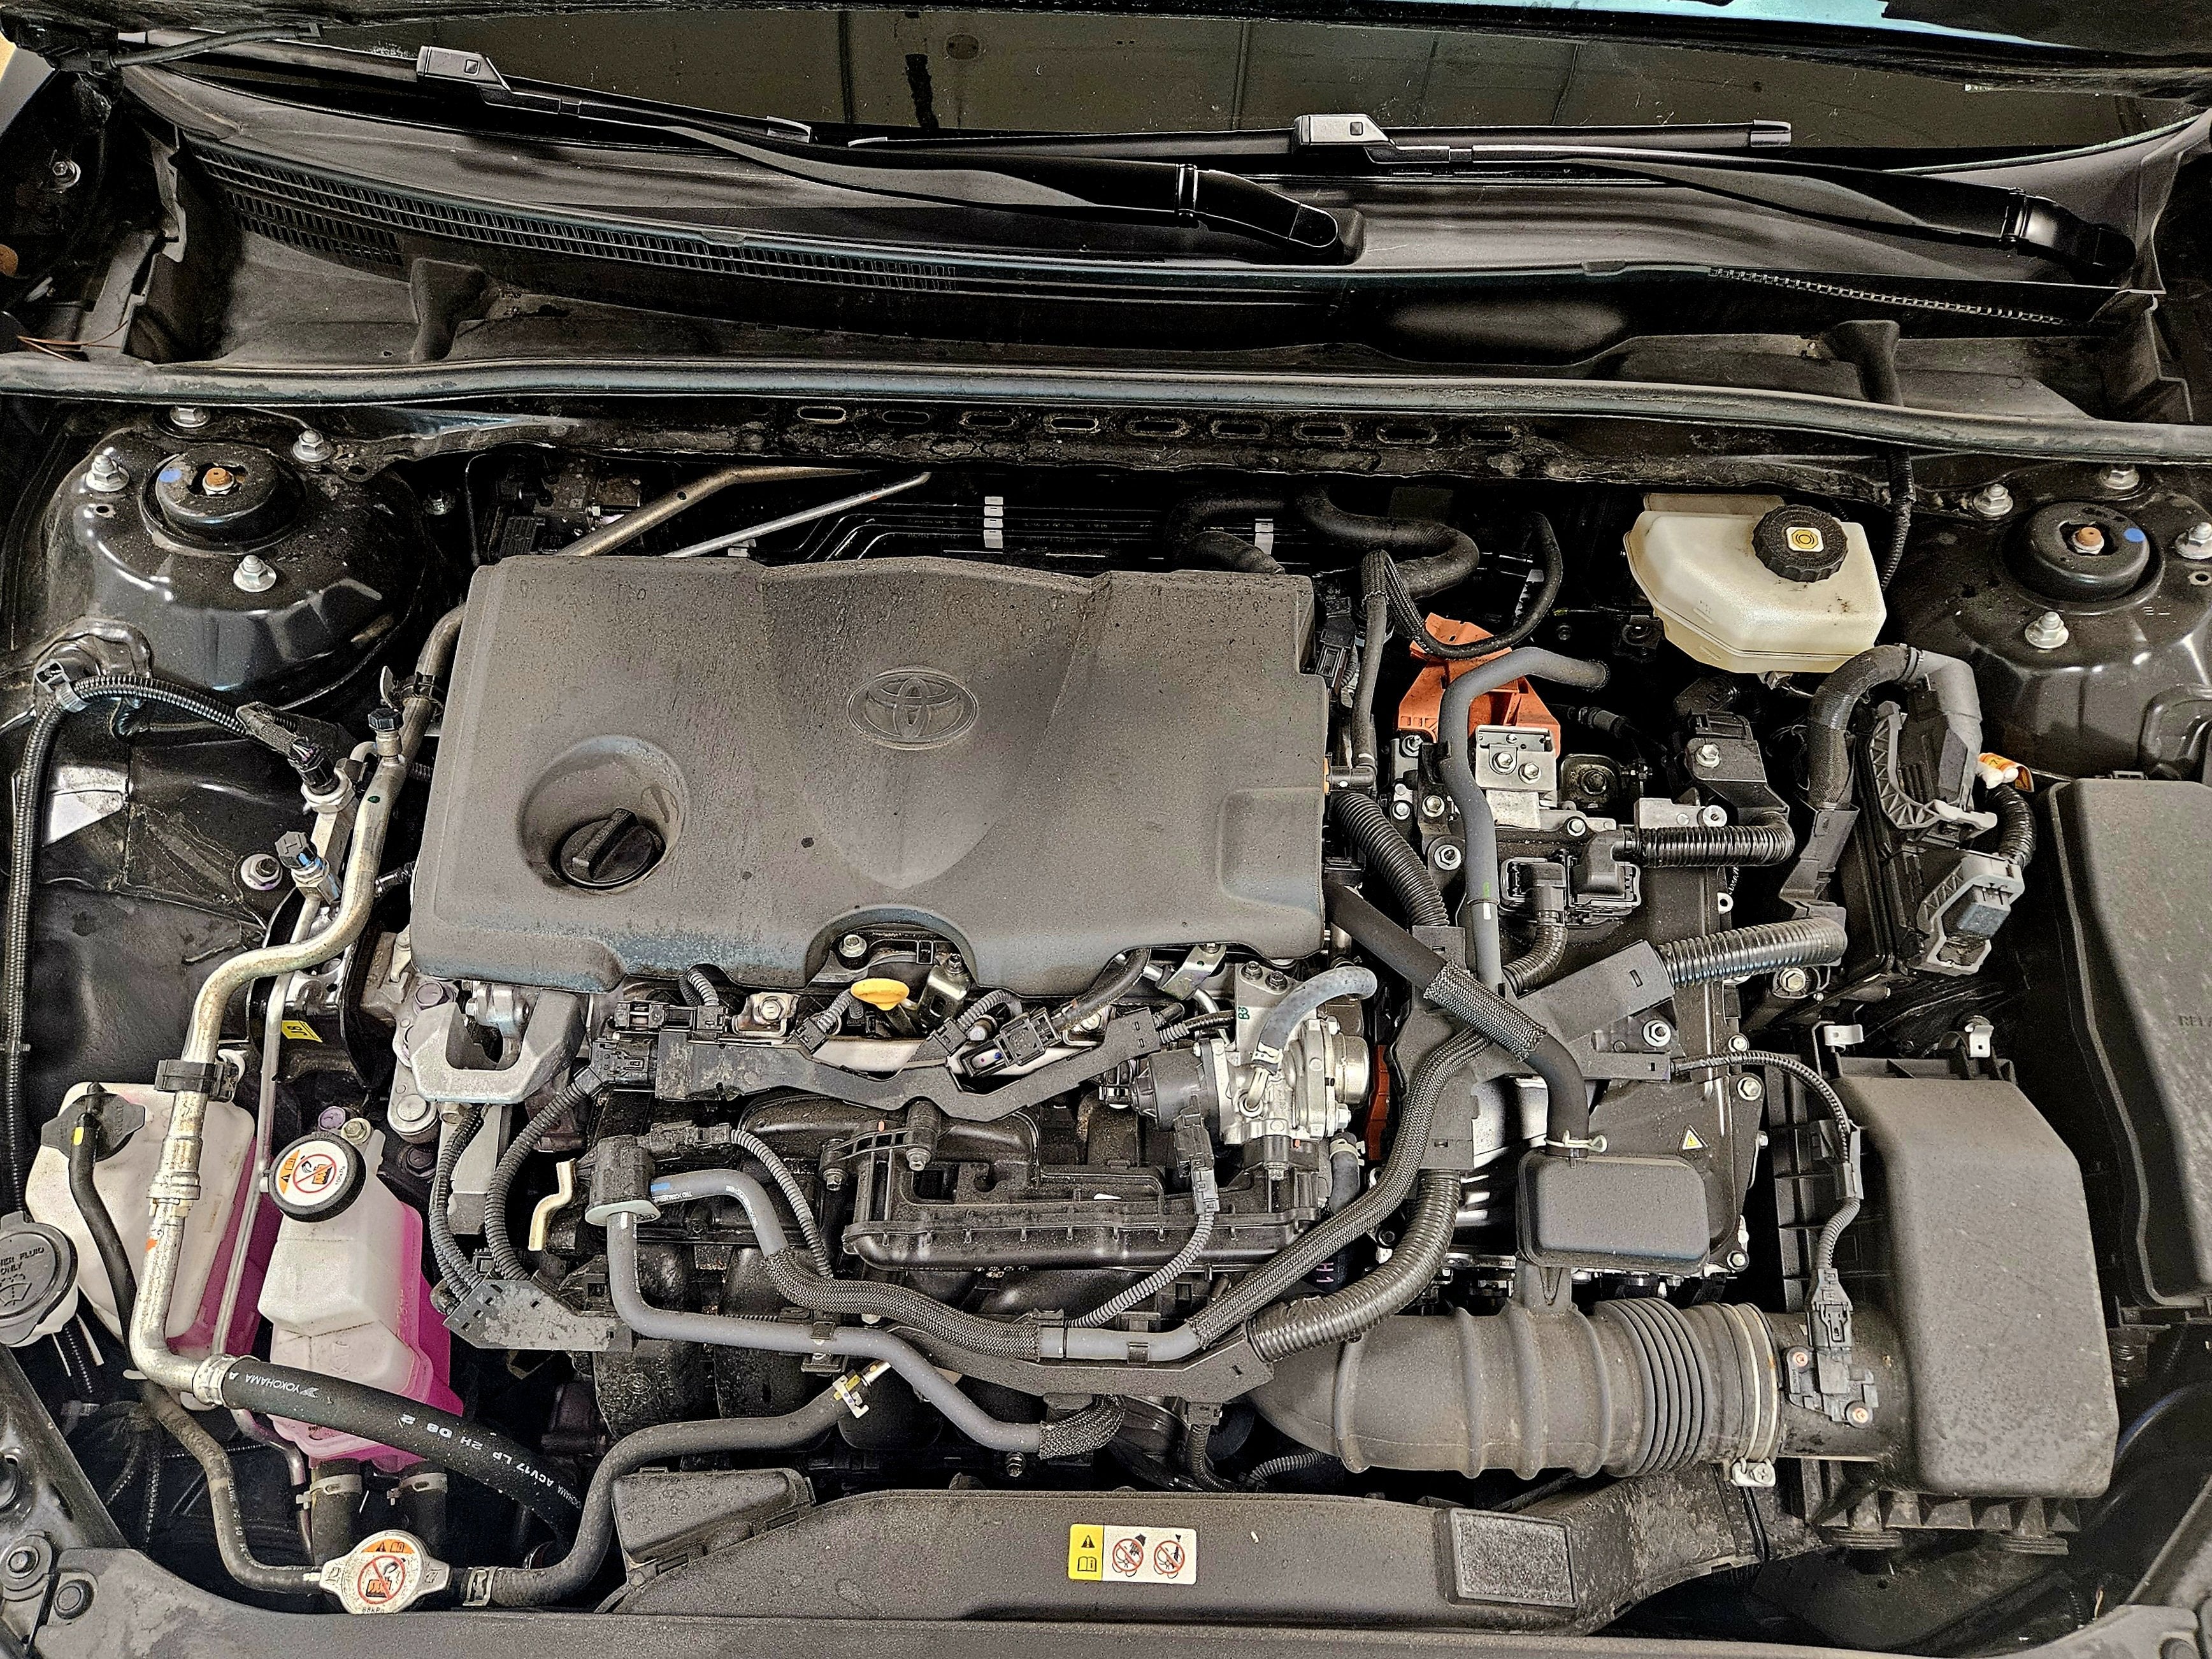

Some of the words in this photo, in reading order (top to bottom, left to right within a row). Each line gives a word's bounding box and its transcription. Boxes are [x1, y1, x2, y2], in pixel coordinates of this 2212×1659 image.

[287, 1026, 308, 1036] J8
[20, 1247, 45, 1260] FLUID
[1316, 1262, 1333, 1282] H1
[246, 1374, 300, 1393] YOKOHAMA
[400, 1414, 416, 1425] 2
[460, 1436, 483, 1451] 2H
[492, 1451, 512, 1465] LP
[516, 1463, 554, 1487] ACV17
